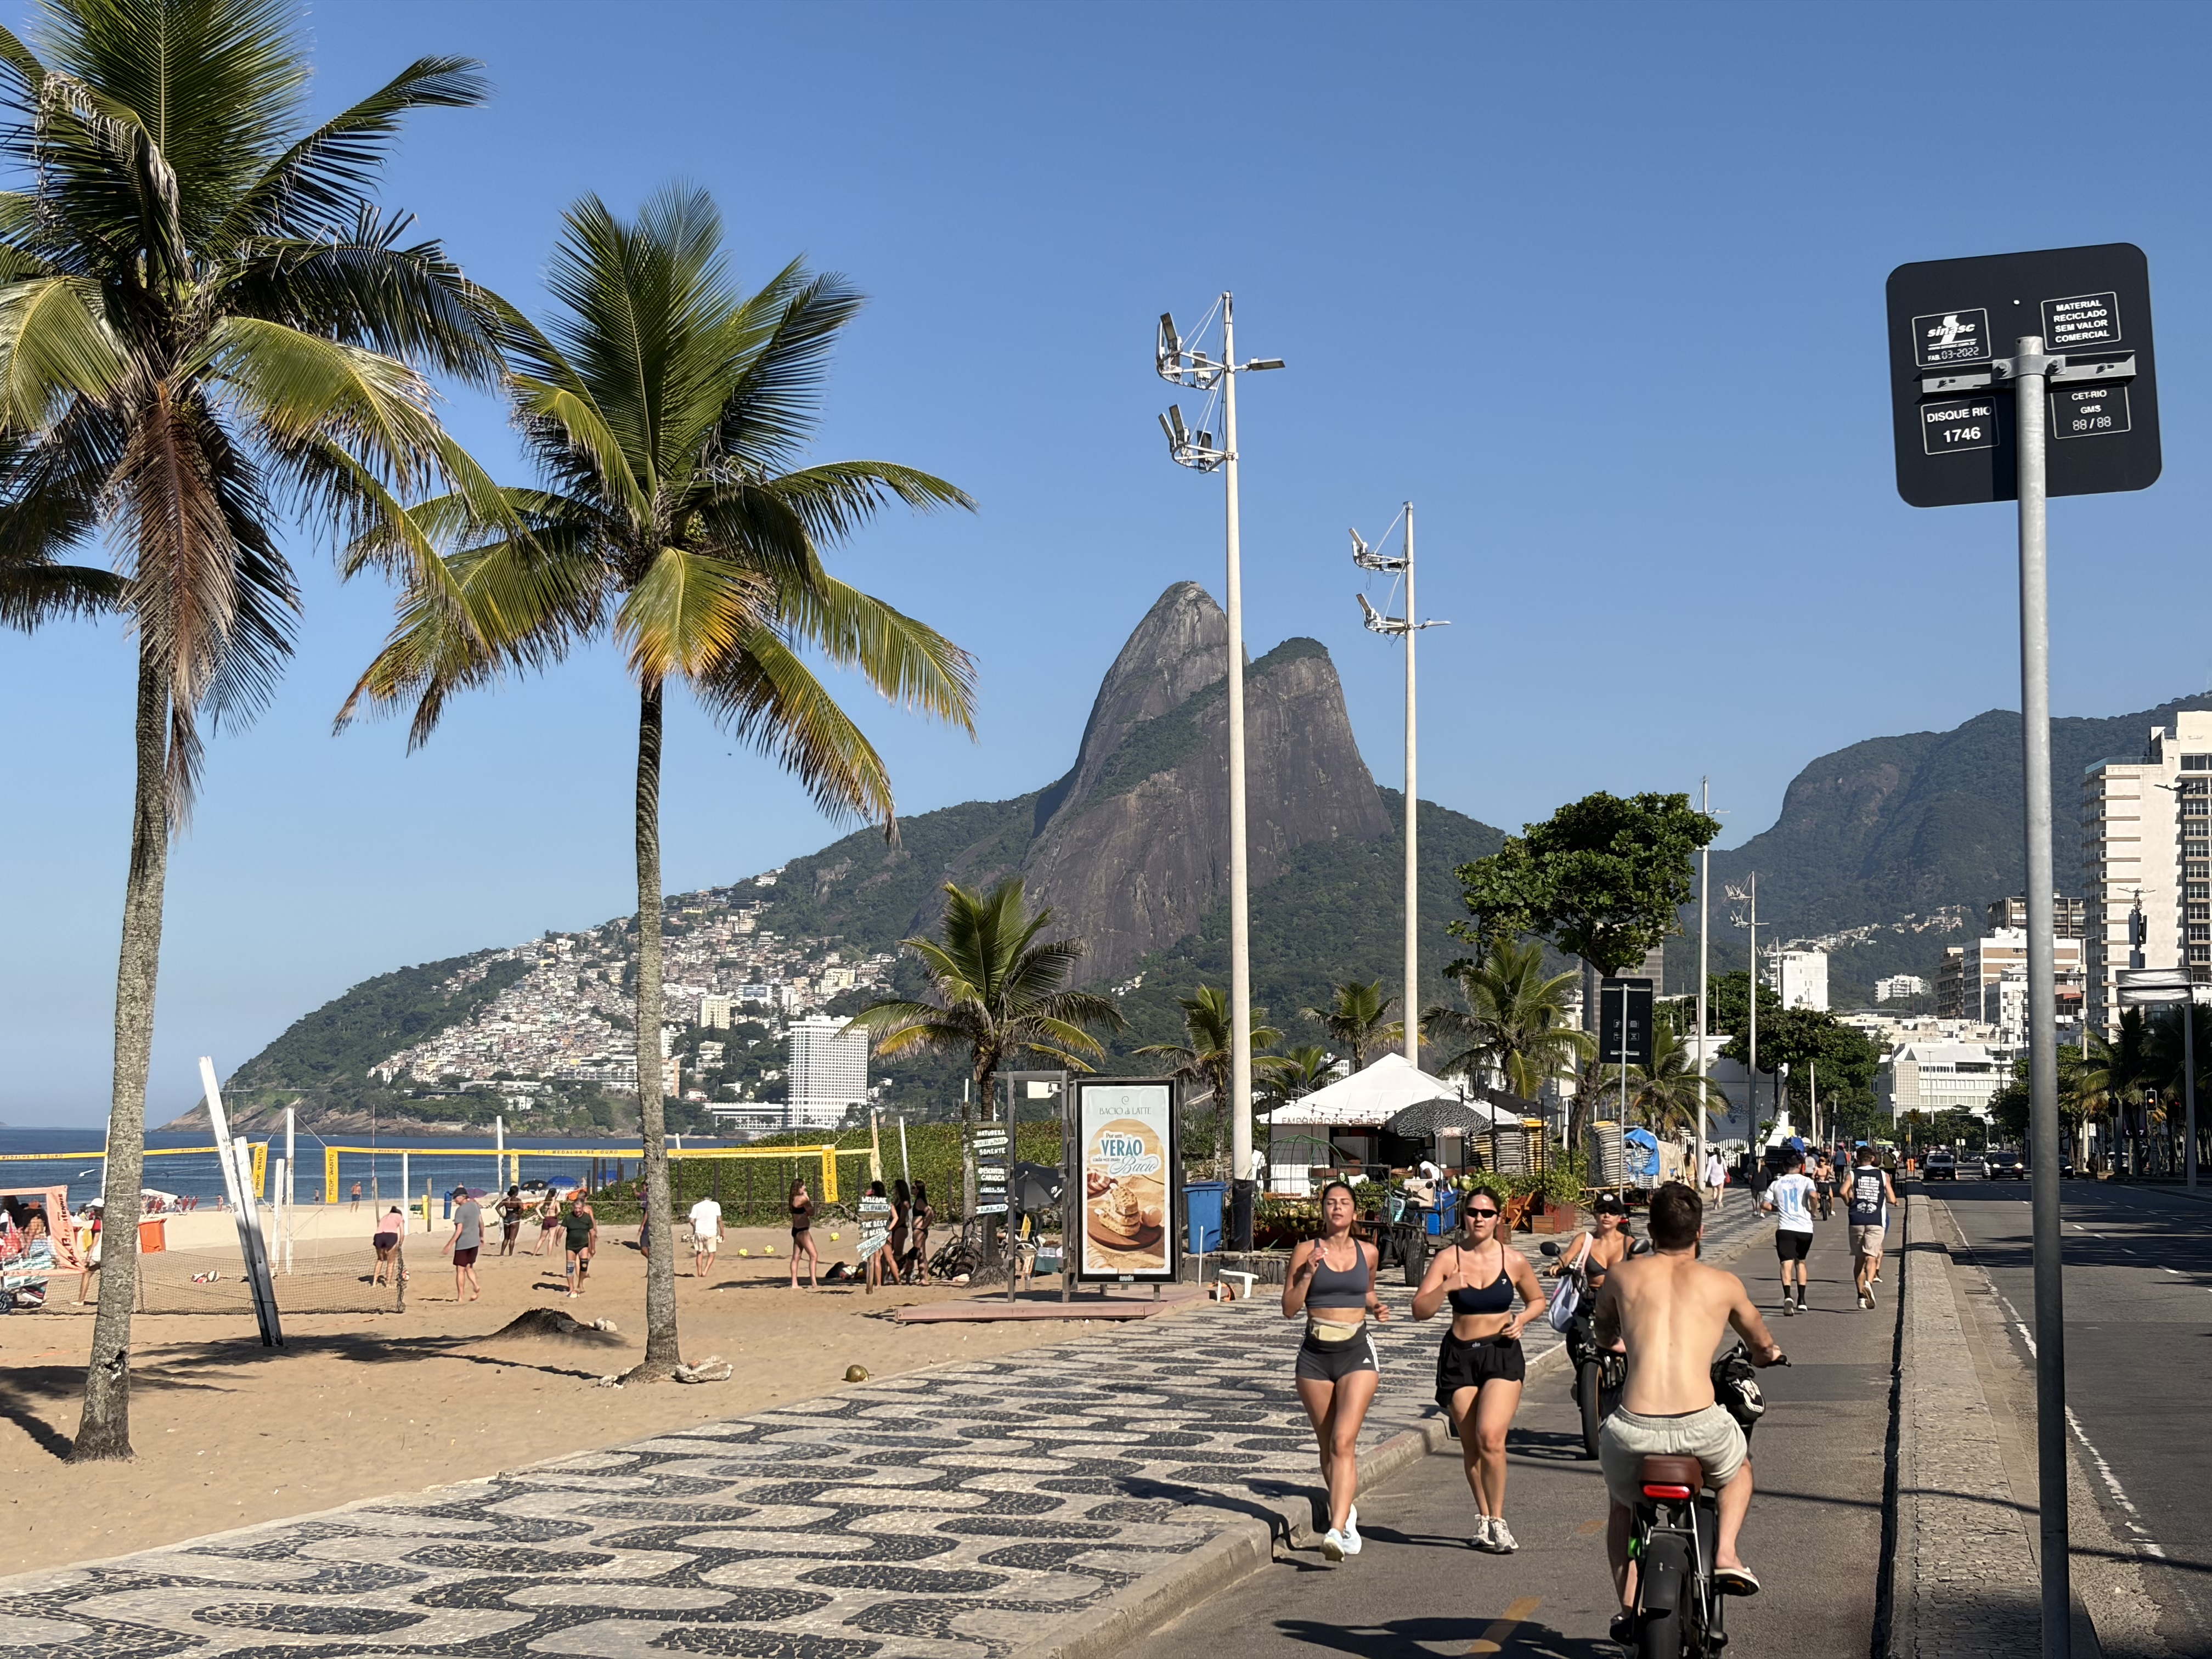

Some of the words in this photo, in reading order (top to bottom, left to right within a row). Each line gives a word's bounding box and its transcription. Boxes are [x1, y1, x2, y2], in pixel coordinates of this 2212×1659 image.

[2056, 300, 2102, 312] MATERIAL
[2053, 309, 2107, 323] RECICLADO
[1927, 324, 1976, 337] sinasc
[2055, 324, 2075, 332] SEM
[2076, 319, 2108, 330] VALOR
[2055, 330, 2110, 343] COMERCIAL
[1942, 347, 1979, 360] 03-2022
[2071, 390, 2107, 400] CET-RIO
[1927, 409, 1970, 422] DISQUE
[1972, 407, 1991, 417] RIO
[2080, 405, 2102, 414] GMS
[1943, 427, 1982, 443] 1746
[1101, 1137, 1143, 1156] VERÃO
[1109, 1155, 1159, 1175] Bacio
[1782, 1188, 1798, 1212] 14
